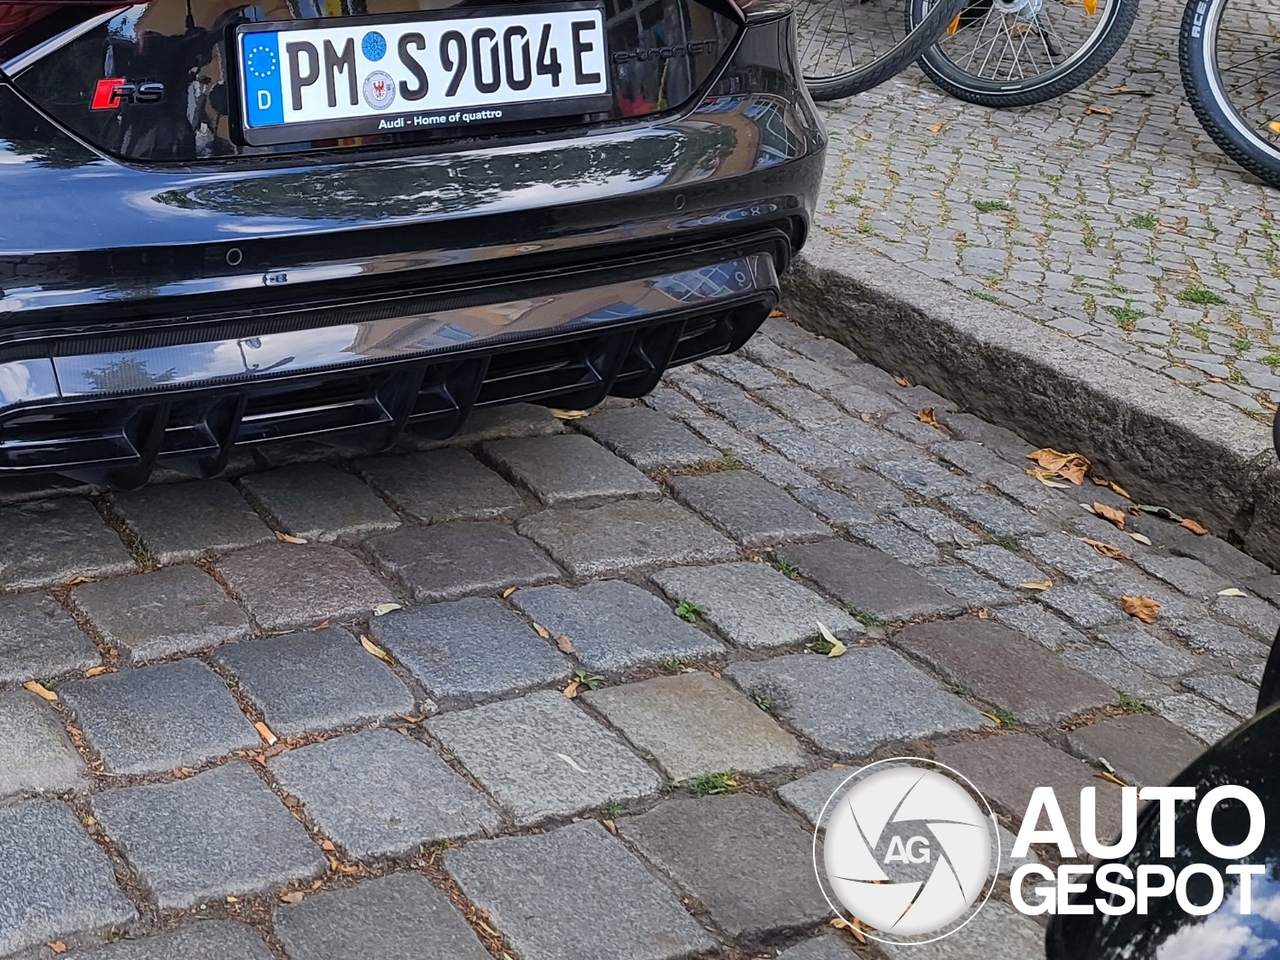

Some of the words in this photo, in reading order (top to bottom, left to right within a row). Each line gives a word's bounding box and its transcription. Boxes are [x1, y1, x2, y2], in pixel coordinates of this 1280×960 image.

[1191, 0, 1207, 38] ACE
[613, 46, 686, 64] e-tron
[687, 39, 719, 55] GT
[286, 37, 359, 111] PM
[107, 81, 165, 105] RS
[257, 90, 272, 110] D
[378, 117, 405, 130] Audi
[414, 114, 446, 126] Home
[448, 112, 461, 122] of
[462, 109, 503, 124] quattro
